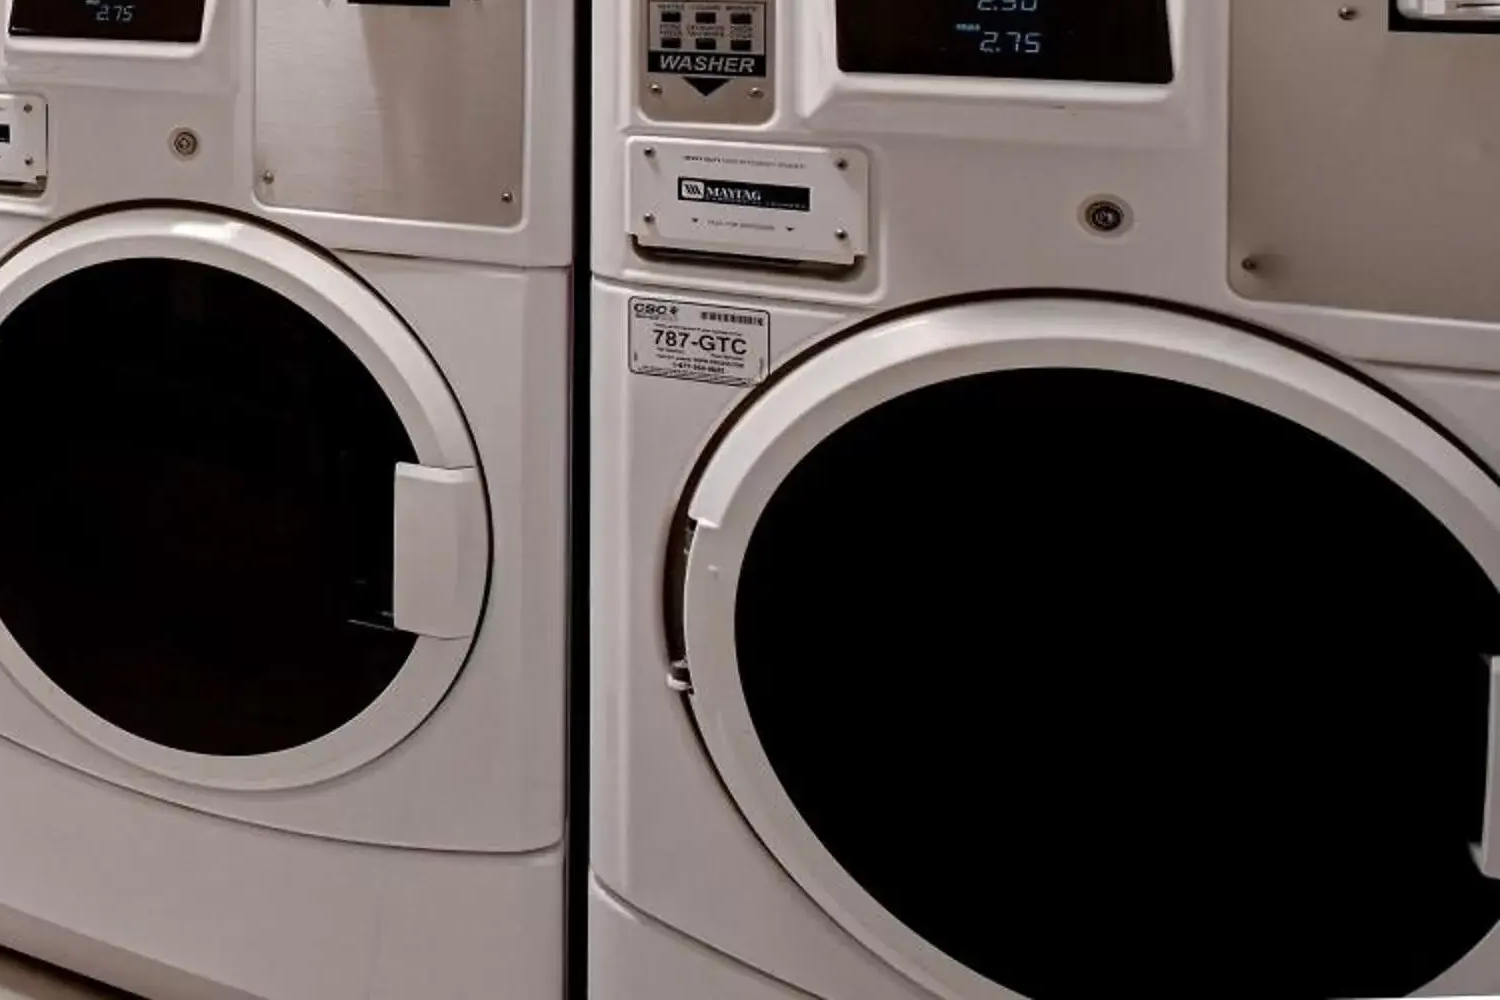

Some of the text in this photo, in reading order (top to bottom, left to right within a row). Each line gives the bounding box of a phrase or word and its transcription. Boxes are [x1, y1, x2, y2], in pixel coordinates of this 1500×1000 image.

[979, 31, 1041, 53] 2.75
[659, 54, 755, 73] WASHER
[706, 184, 762, 201] MAYTAG
[633, 302, 667, 316] CSC
[652, 329, 748, 356] 787-GTC
